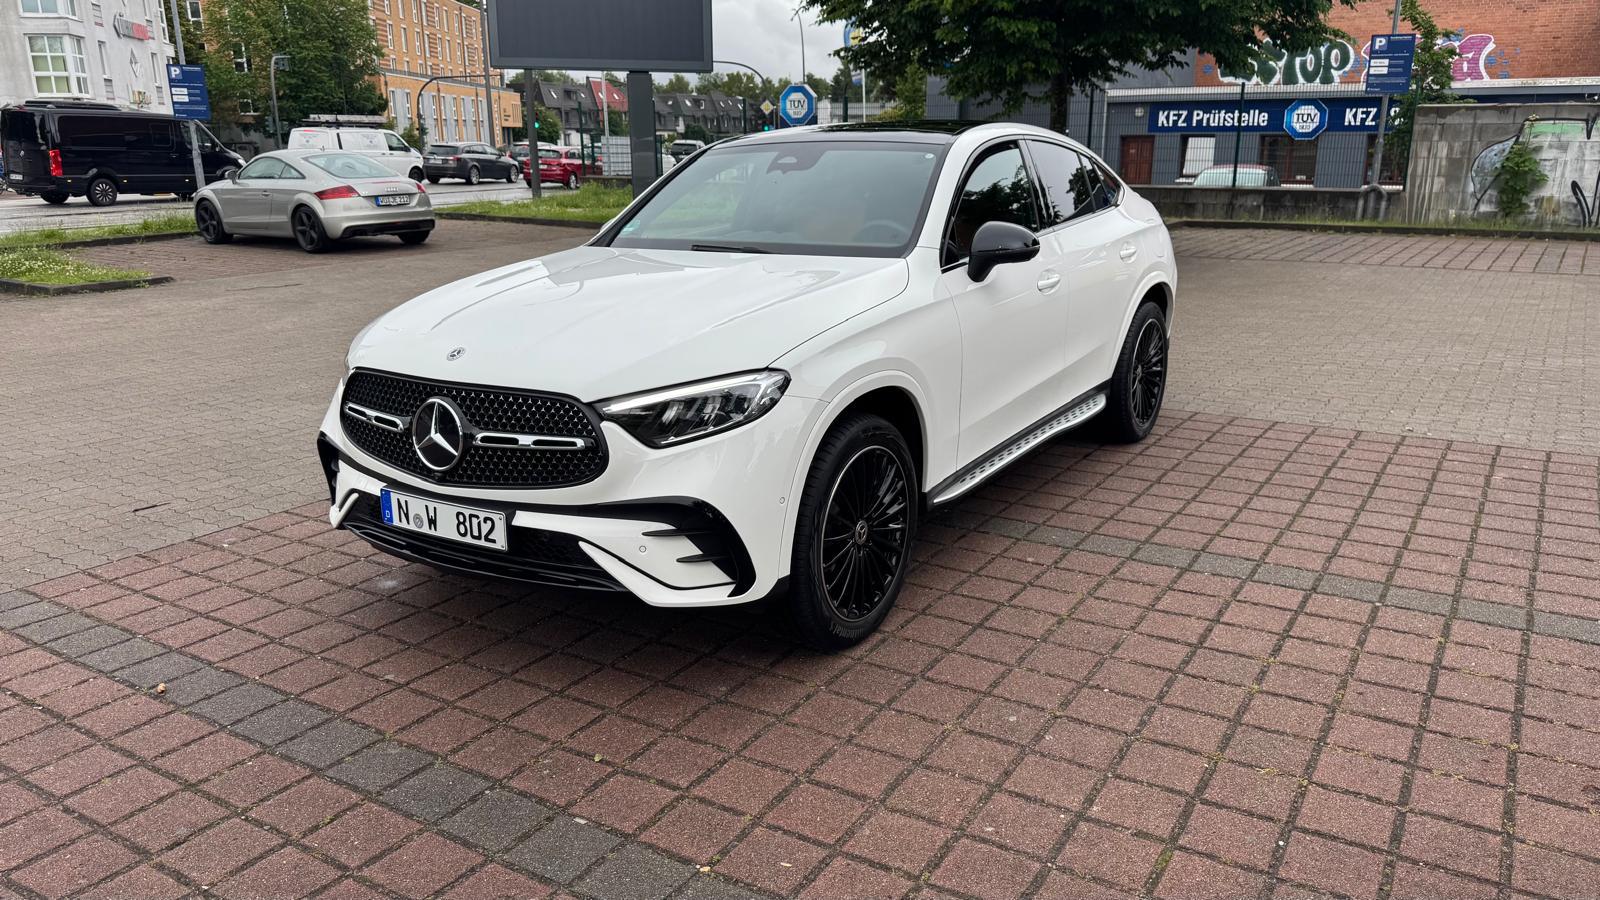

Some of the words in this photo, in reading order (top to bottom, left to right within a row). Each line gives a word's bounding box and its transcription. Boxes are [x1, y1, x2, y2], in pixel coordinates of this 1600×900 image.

[1375, 38, 1386, 49] P
[170, 66, 181, 78] P
[1158, 110, 1188, 127] KFZ
[1192, 109, 1269, 127] Prüfstelle
[1344, 107, 1378, 126] KFZ
[397, 497, 410, 525] N
[425, 504, 438, 532] W
[455, 511, 497, 544] 802
